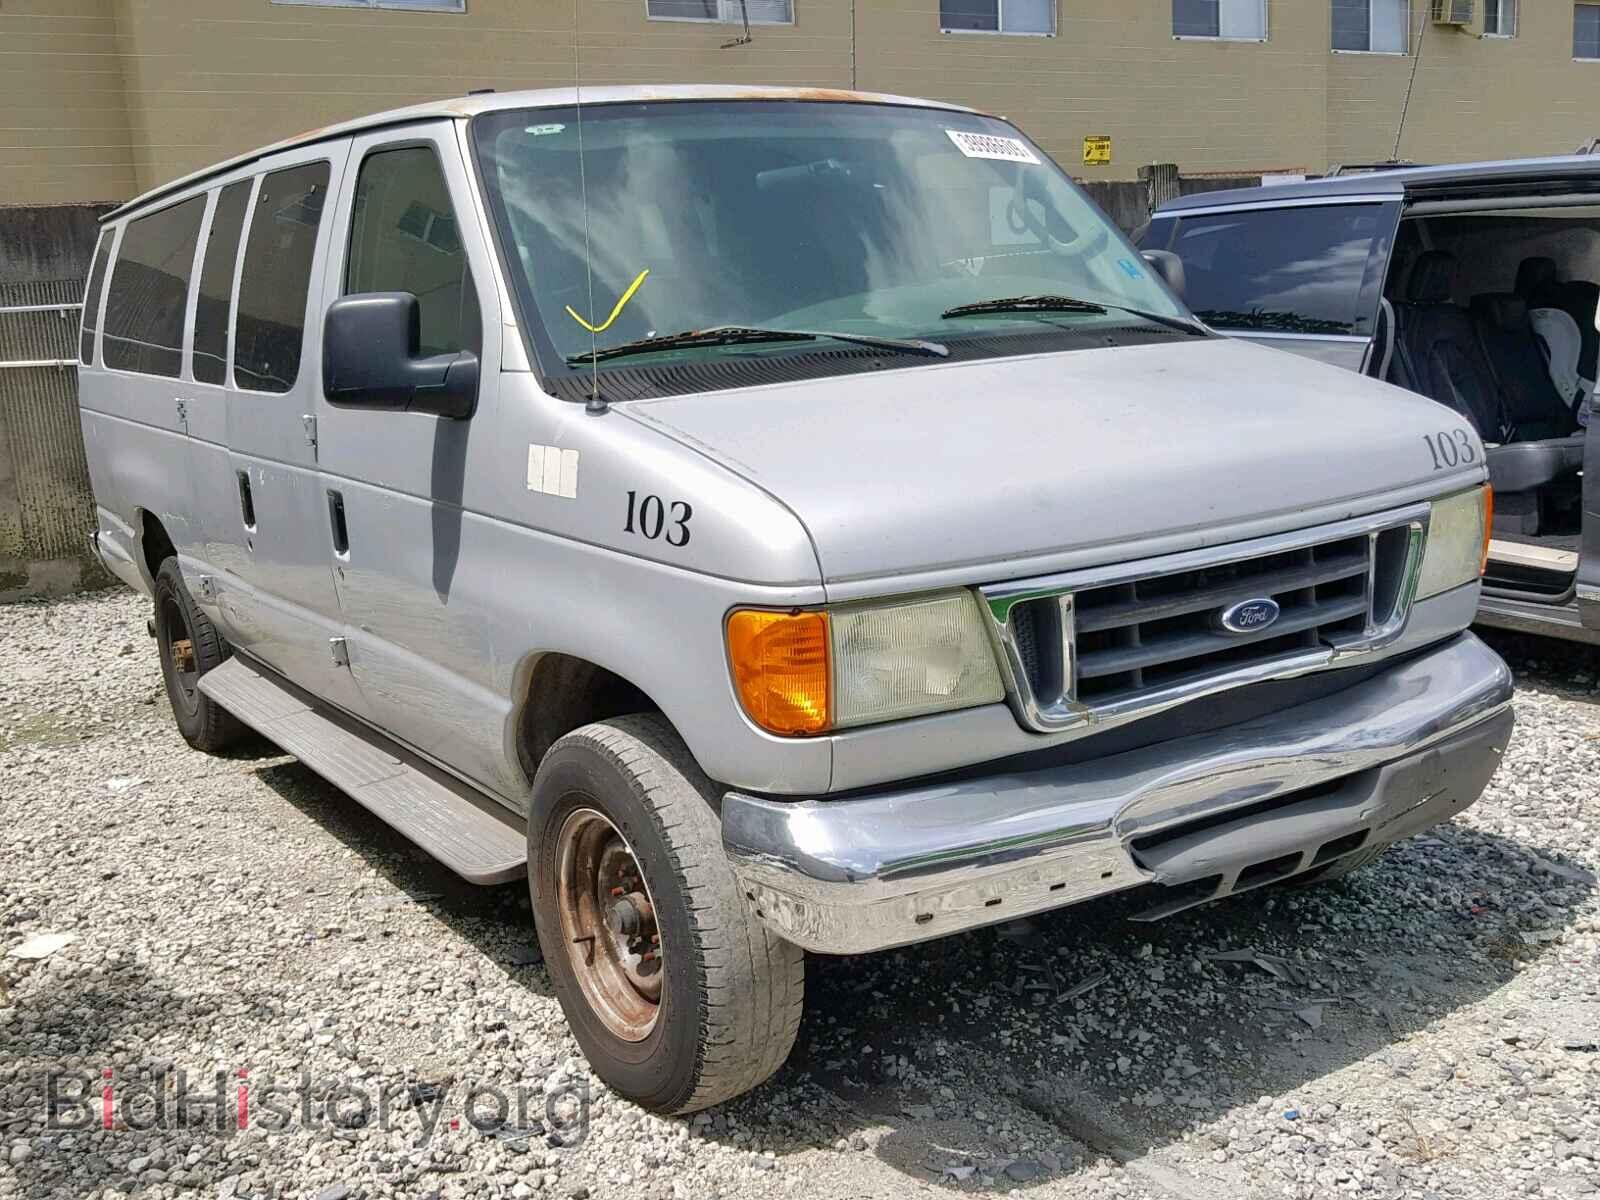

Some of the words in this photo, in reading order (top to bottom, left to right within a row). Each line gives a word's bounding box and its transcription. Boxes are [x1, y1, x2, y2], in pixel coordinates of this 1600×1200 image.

[1422, 428, 1474, 470] 103
[623, 490, 693, 547] 103
[1239, 605, 1268, 626] Ford
